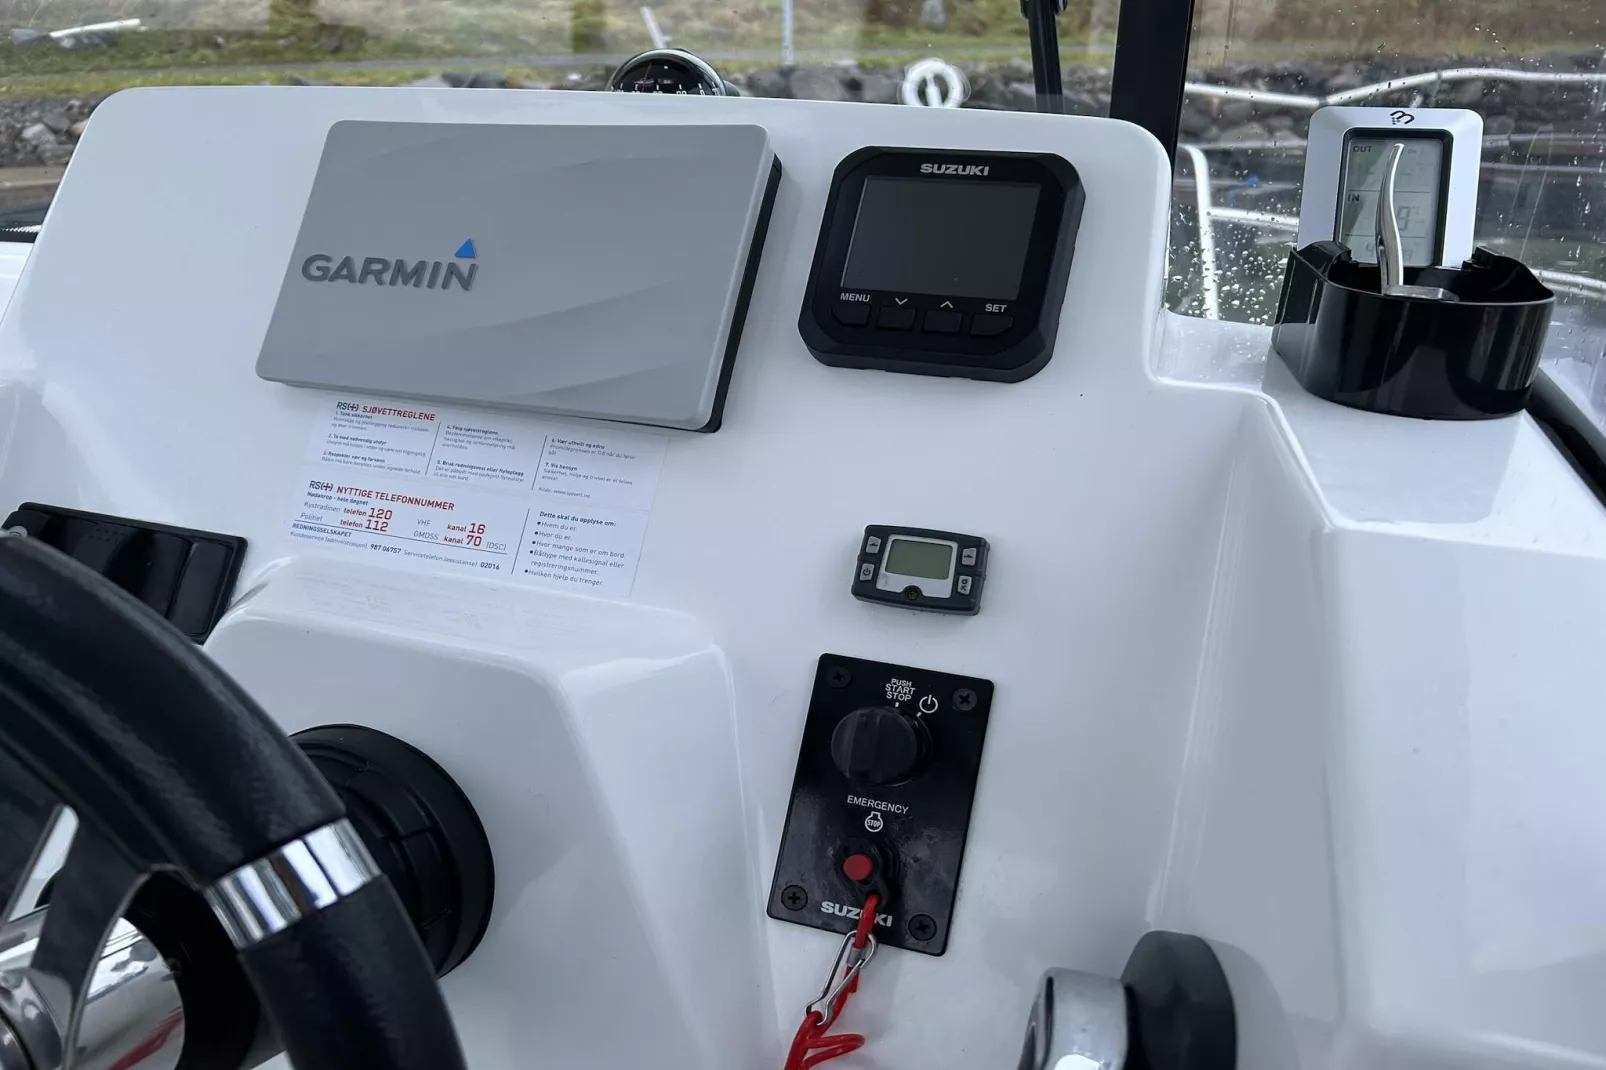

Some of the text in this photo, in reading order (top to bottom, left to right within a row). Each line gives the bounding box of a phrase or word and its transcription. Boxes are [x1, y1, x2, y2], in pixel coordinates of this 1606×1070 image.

[920, 163, 990, 176] SUZUKI
[1348, 194, 1360, 202] IN
[301, 254, 478, 292] GARMIN
[840, 292, 870, 302] MENU
[985, 304, 1007, 313] SET
[362, 405, 436, 421] SJØVETTREGLENE
[307, 491, 332, 500] Nødanrop
[349, 498, 368, 506] døgnet
[336, 486, 374, 498] NYTTIGE
[375, 492, 455, 511] TELEFONNUMMER
[304, 501, 392, 520] Kystradioen telefon 120
[292, 522, 352, 537] REDNINGSSELSKAPET
[340, 519, 363, 528] telefon
[365, 519, 388, 532] 112
[447, 524, 467, 532] kanal
[468, 523, 486, 534] 16
[414, 530, 439, 540] GMDSS
[444, 535, 463, 544] kanal
[466, 534, 482, 547] 70
[552, 543, 573, 551] mange
[480, 561, 500, 570] 02016
[553, 572, 568, 581] hjelp
[891, 678, 912, 687] PUSH
[885, 684, 916, 695] START
[886, 692, 912, 702] STOP
[847, 795, 909, 814] EMERGENCY
[867, 819, 881, 828] STOP
[820, 901, 893, 927] SUZKI
